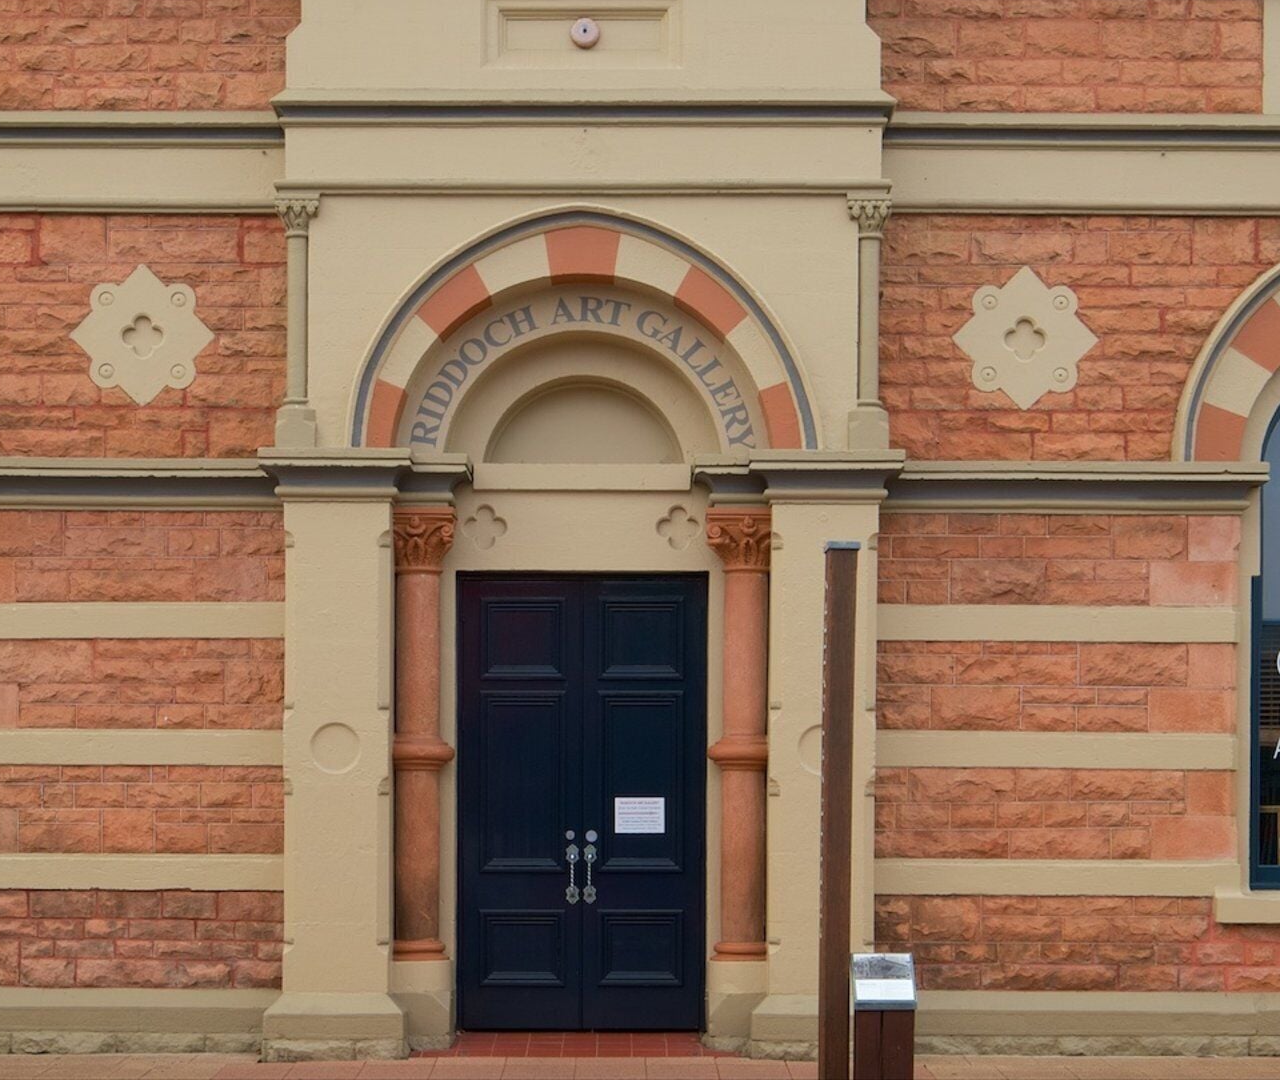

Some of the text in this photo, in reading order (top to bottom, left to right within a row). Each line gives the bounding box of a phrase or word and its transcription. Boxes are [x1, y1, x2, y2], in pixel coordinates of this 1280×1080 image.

[409, 295, 756, 449] RIDDOCH ART GALLERY
